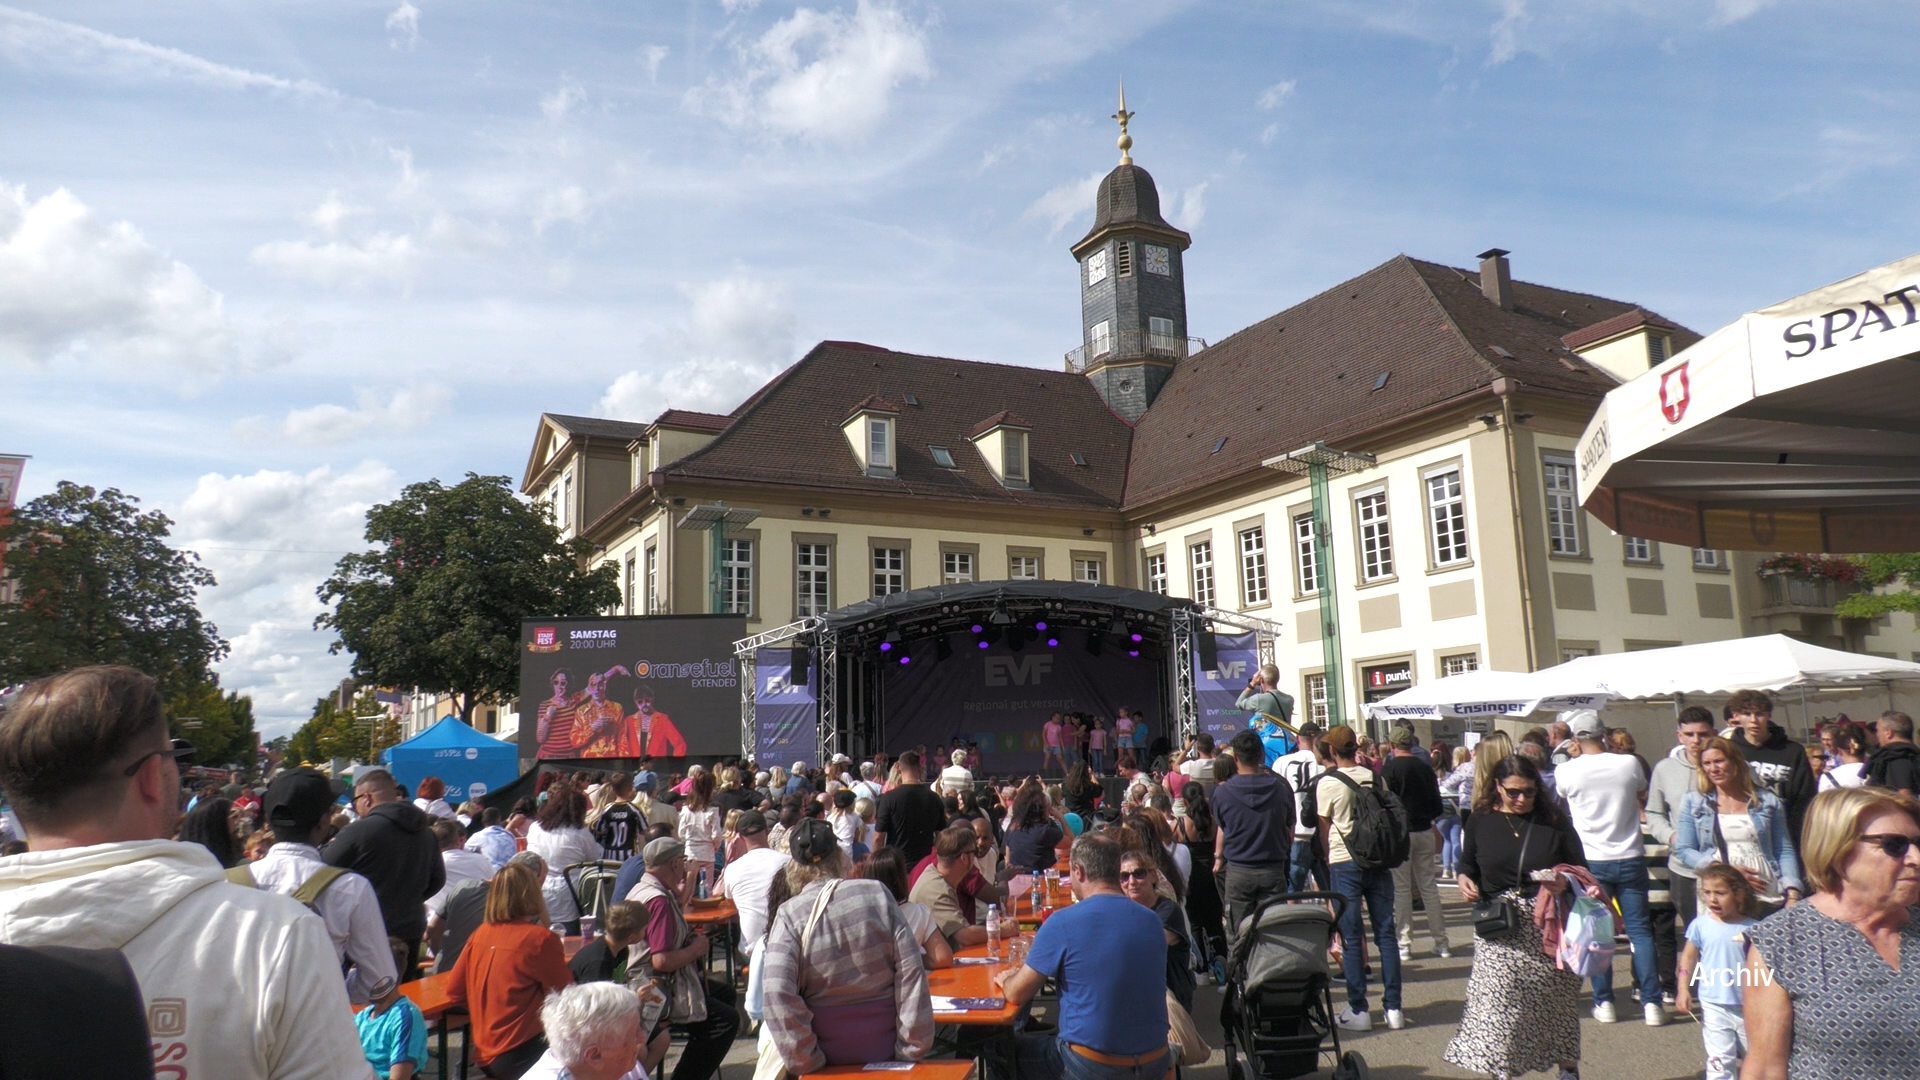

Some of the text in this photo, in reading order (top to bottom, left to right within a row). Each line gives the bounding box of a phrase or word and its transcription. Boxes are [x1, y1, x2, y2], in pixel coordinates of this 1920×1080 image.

[1783, 284, 1920, 361] SPAT
[569, 629, 617, 639] SAMSTAG
[569, 639, 617, 649] 20:00 UHR
[634, 657, 737, 679] Orangefuel
[984, 654, 1054, 687] EVF
[1385, 669, 1412, 684] punkt
[691, 678, 737, 688] EXTENDED
[963, 699, 1008, 712] Regional
[1010, 700, 1029, 712] gut
[1384, 705, 1435, 717] Ensinger
[1453, 702, 1527, 714] Ensinger
[1222, 723, 1236, 731] Gas
[610, 821, 628, 847] 10
